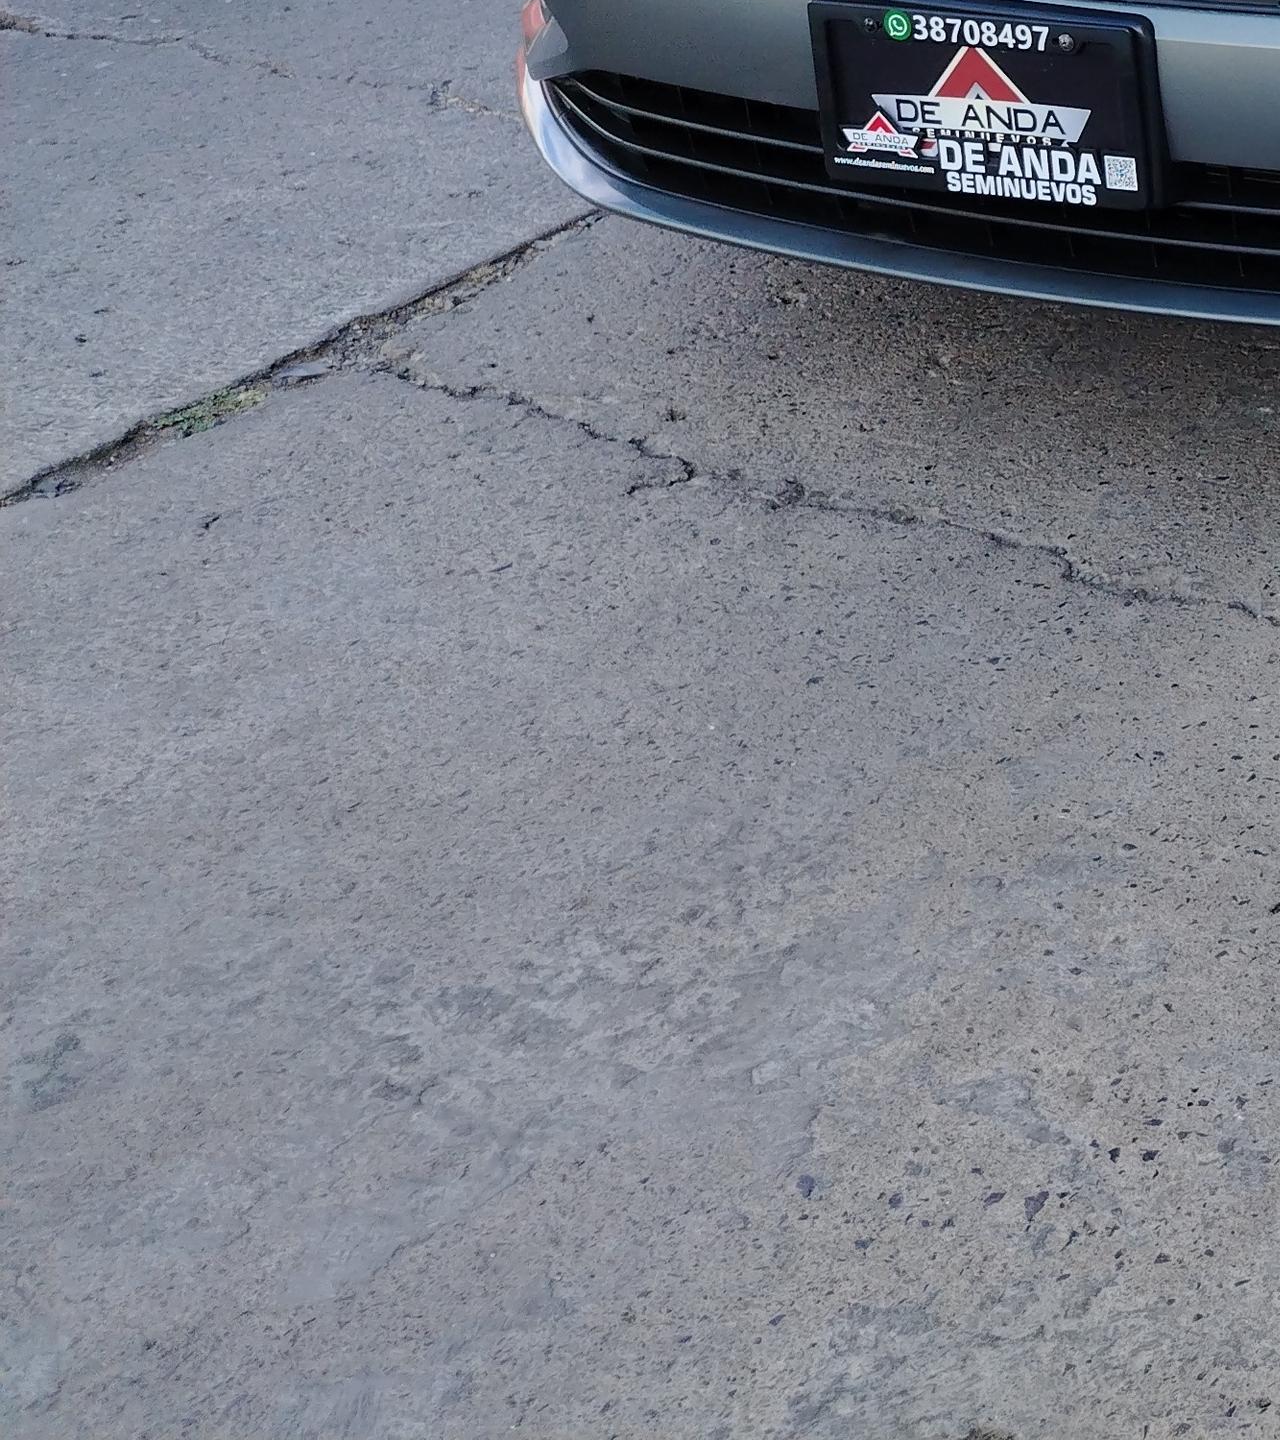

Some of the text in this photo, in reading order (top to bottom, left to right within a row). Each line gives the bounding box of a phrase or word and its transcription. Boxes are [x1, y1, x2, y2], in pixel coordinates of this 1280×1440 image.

[912, 14, 1050, 52] 38708497
[895, 98, 1067, 136] DE ANDA
[852, 132, 868, 141] DE
[874, 133, 909, 146] ANDA
[938, 138, 1102, 185] DE ANDA
[946, 172, 1098, 206] SEMINUEVOS
